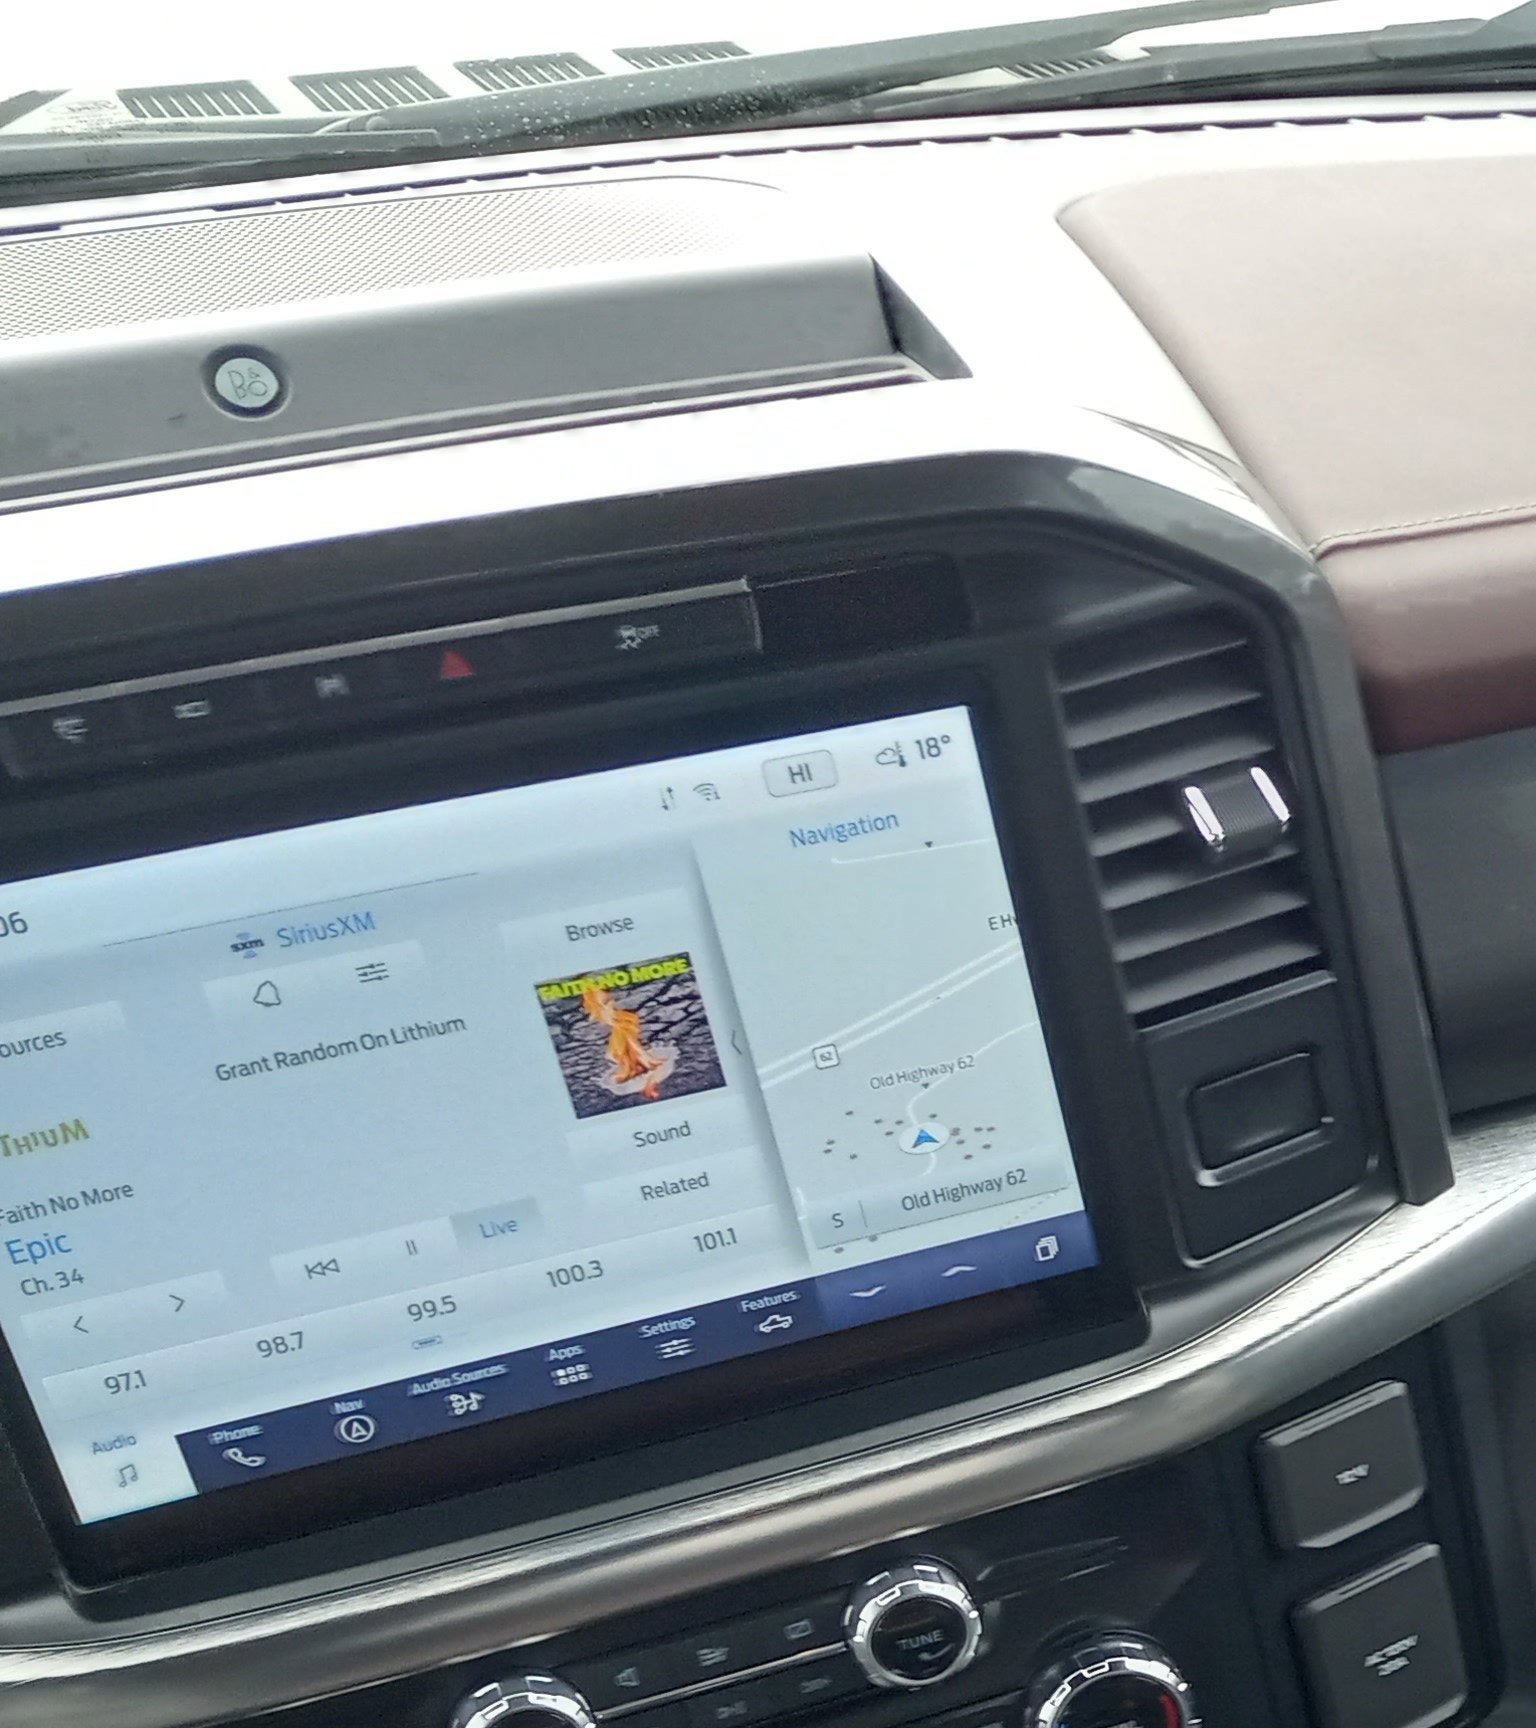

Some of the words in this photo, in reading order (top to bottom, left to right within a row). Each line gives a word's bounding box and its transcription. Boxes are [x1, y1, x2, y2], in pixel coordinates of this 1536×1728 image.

[787, 763, 813, 785] HI
[788, 810, 900, 848] Navigation
[276, 910, 376, 949] SiriusXM
[564, 916, 635, 942] Browse
[987, 916, 999, 931] E
[600, 970, 630, 990] NO
[630, 957, 689, 984] MORE
[215, 1057, 273, 1082] Grant
[274, 1038, 359, 1070] Random
[360, 1032, 390, 1052] On
[390, 1015, 468, 1046] Lithium
[869, 1074, 895, 1091] Old
[897, 1062, 955, 1086] Highway
[957, 1055, 976, 1071] 62
[633, 1120, 692, 1149] Sound
[48, 1196, 80, 1215] No
[81, 1183, 135, 1206] More
[639, 1172, 710, 1202] Related
[831, 1212, 845, 1230] S
[901, 1192, 935, 1213] Old
[936, 1176, 1004, 1207] Highway
[1006, 1168, 1028, 1188] 62
[477, 1217, 518, 1239] Live
[692, 1226, 739, 1253] 101.1
[5, 1231, 73, 1266] Epic
[20, 1276, 55, 1298] Ch.
[58, 1268, 86, 1289] 34
[545, 1259, 605, 1289] 100.3
[406, 1294, 458, 1323] 99.5
[740, 1289, 799, 1313] Features
[640, 1314, 697, 1339] Settings
[255, 1331, 305, 1359] 98.7
[547, 1344, 586, 1363] Apps
[103, 1369, 148, 1395] 97.1
[409, 1375, 451, 1396] Audio
[450, 1363, 509, 1387] Sources
[332, 1398, 365, 1414] Nav
[90, 1432, 138, 1455] Audio
[210, 1423, 264, 1446] Phone
[896, 1629, 945, 1650] TUNE
